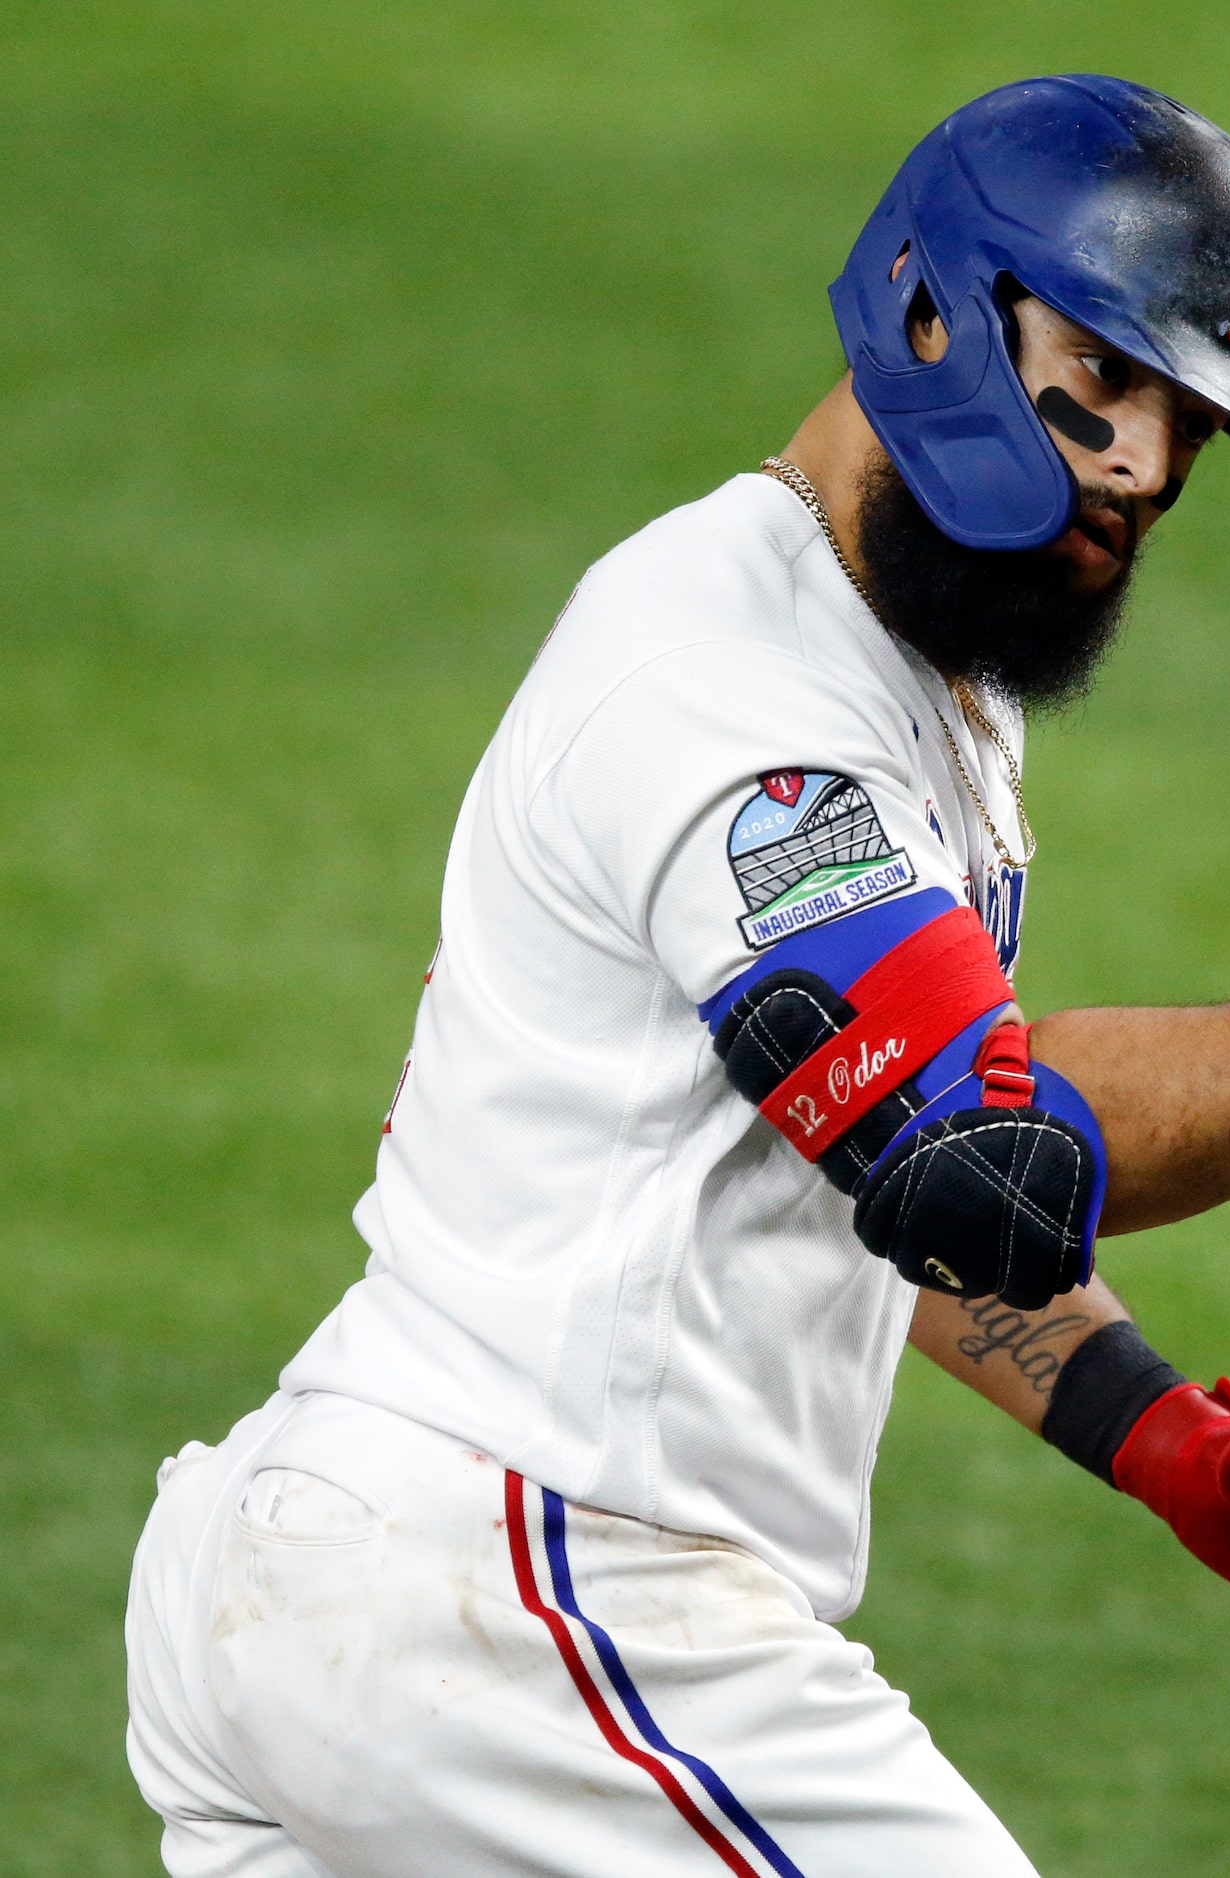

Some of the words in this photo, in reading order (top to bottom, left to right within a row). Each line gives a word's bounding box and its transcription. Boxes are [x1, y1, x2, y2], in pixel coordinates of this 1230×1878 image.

[771, 773, 796, 798] T
[738, 811, 786, 840] 2020
[752, 890, 847, 942] INAUGURAL
[845, 862, 908, 902] SEASON
[787, 1094, 828, 1138] 12
[828, 1038, 906, 1104] Odor
